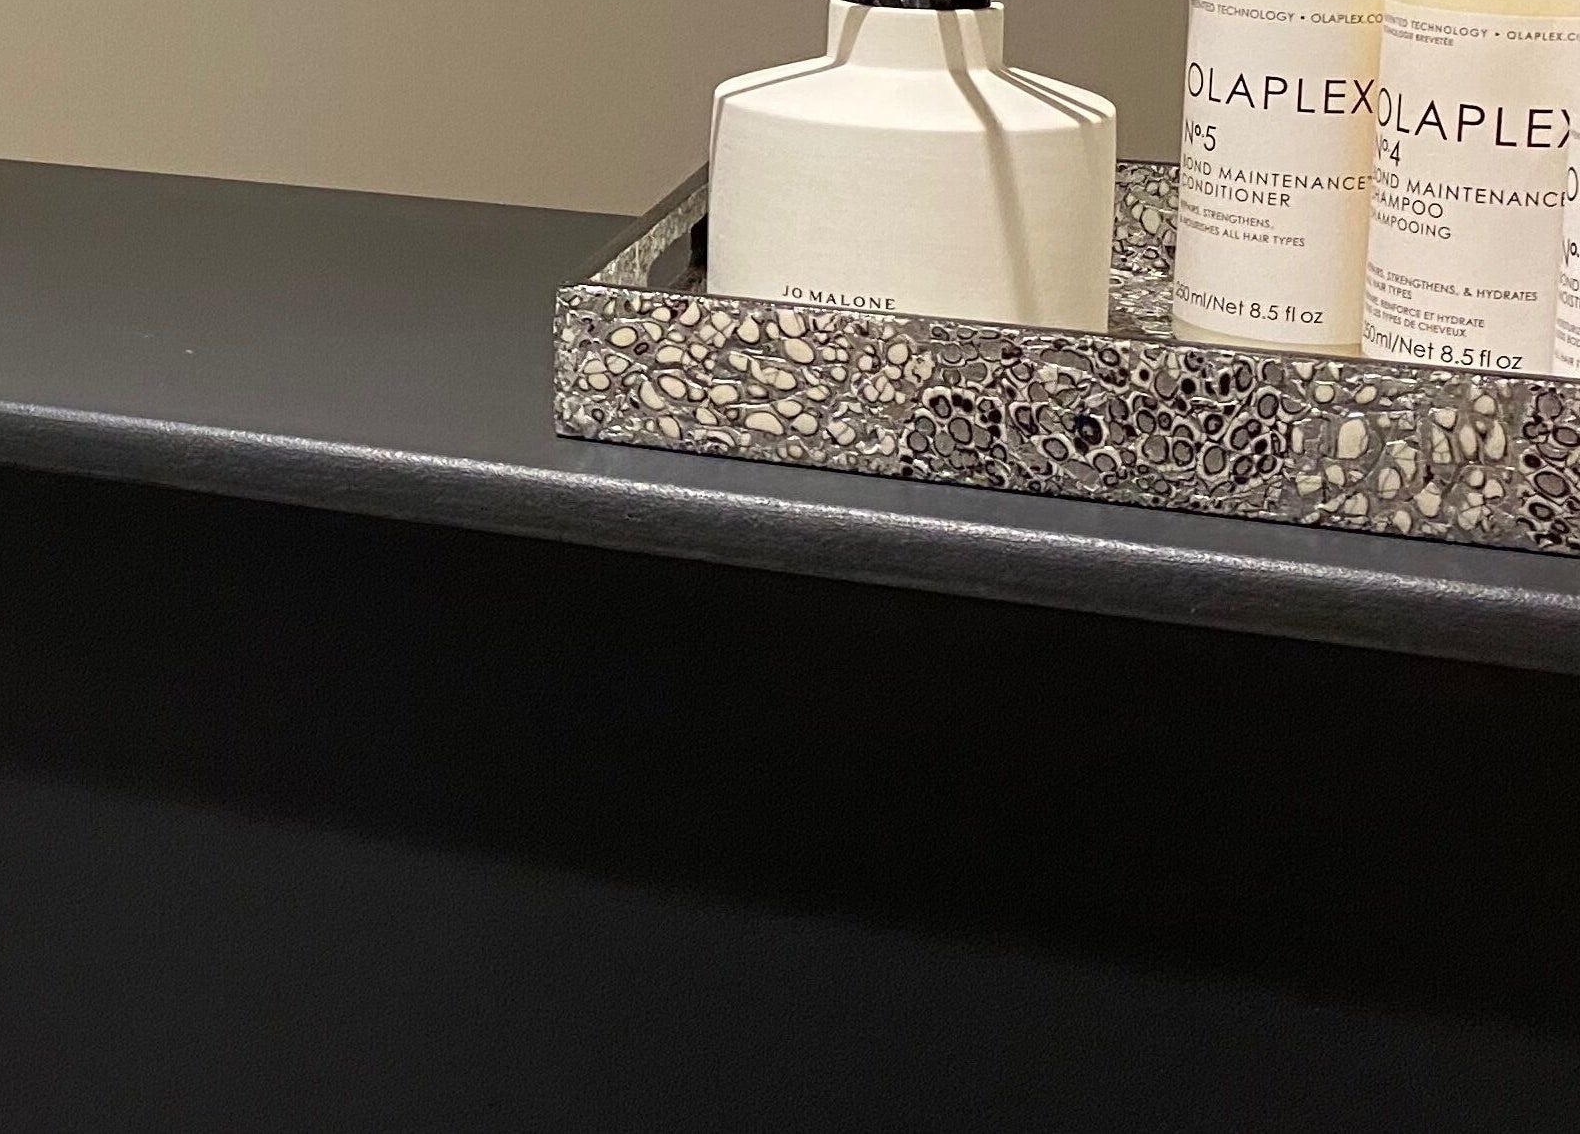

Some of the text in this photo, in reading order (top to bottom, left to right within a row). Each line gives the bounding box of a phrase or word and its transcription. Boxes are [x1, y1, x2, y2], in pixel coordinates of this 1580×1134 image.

[1217, 3, 1295, 22] TECHNOLOGY
[1311, 13, 1383, 24] OLAPLEX.CO
[1411, 20, 1488, 38] TECHNOLOGY
[1188, 61, 1375, 115] OLAPLEX
[1375, 167, 1400, 189] OND
[1182, 172, 1291, 207] CONDITIONER
[1373, 188, 1444, 219] AMPOO
[1222, 228, 1240, 240] ALL
[1243, 232, 1269, 244] HAIR
[1272, 235, 1305, 247] TYPES
[783, 285, 896, 310] JO MALONE
[1463, 286, 1473, 297] &
[1476, 288, 1538, 302] HYDRATES
[1250, 302, 1278, 321] 8.5
[1285, 306, 1296, 322] fl
[1300, 311, 1324, 325] oz
[1424, 311, 1435, 321] ET
[1437, 314, 1485, 328] HYDRATE
[1404, 318, 1416, 330] DE
[1418, 322, 1467, 338] CHEVEUX
[1363, 321, 1523, 370] 50ml/Net 8.5 fl oz
